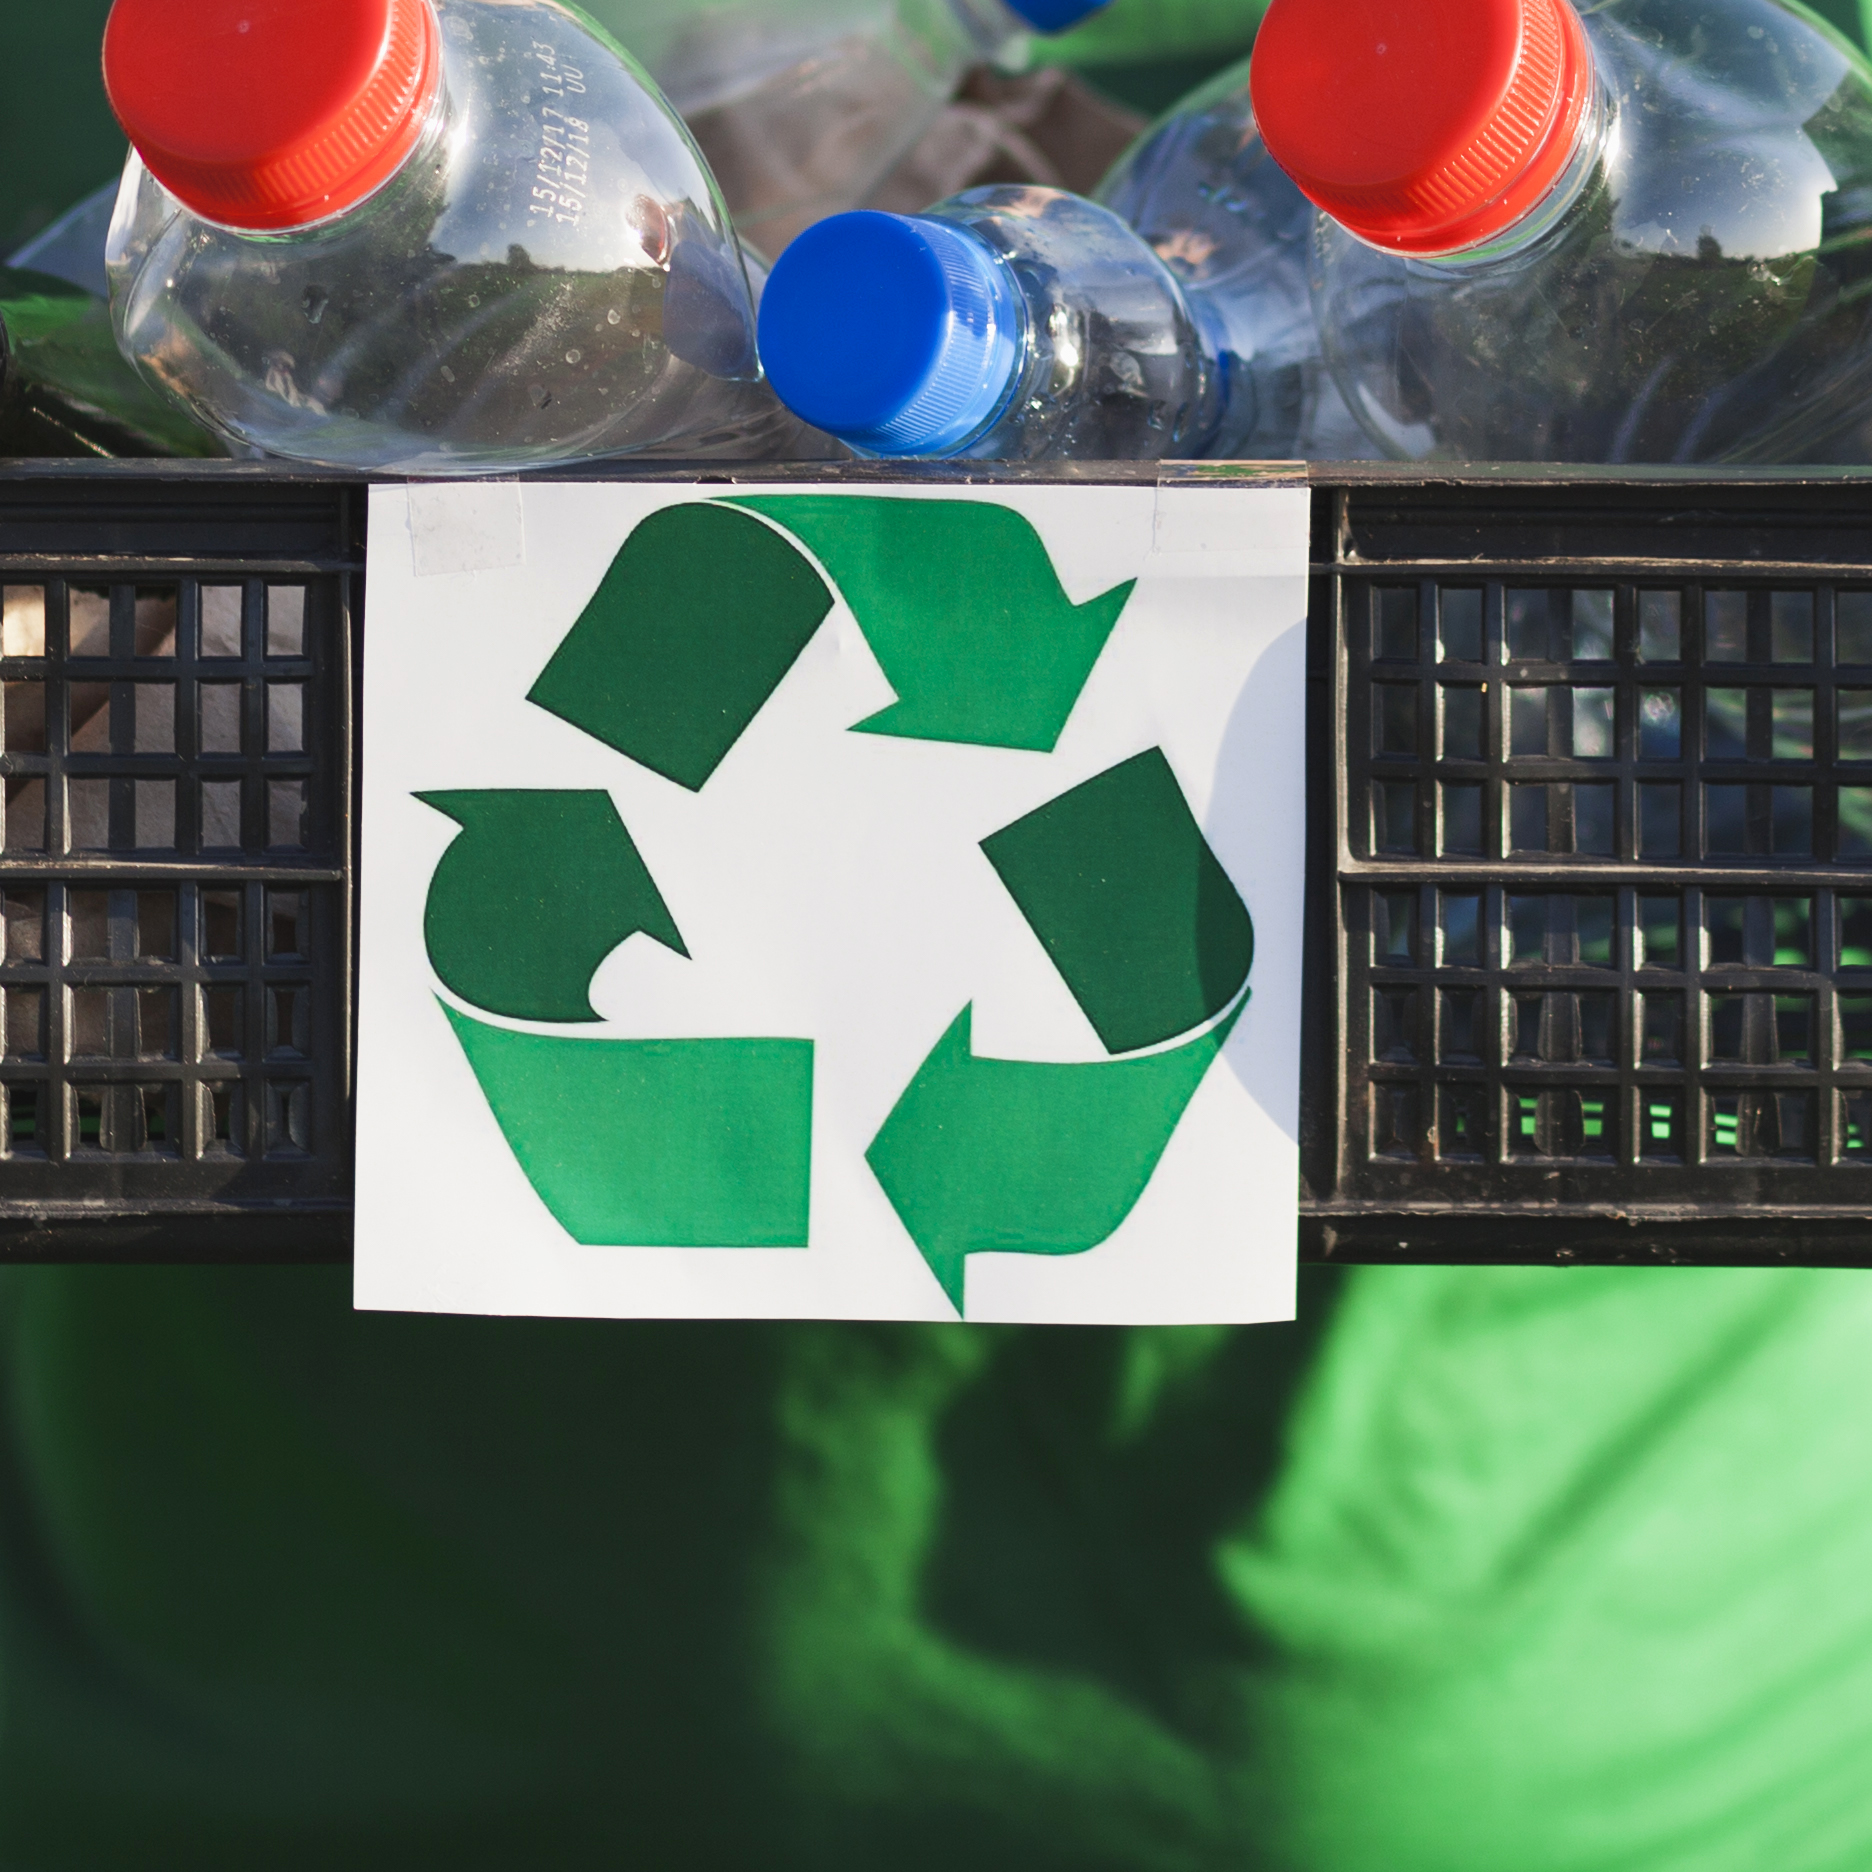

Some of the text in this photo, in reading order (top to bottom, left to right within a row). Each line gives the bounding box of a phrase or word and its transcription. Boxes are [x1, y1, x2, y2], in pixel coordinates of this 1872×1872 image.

[530, 40, 566, 218] 15/12/17 11:43
[555, 115, 590, 226] 15/12/18
